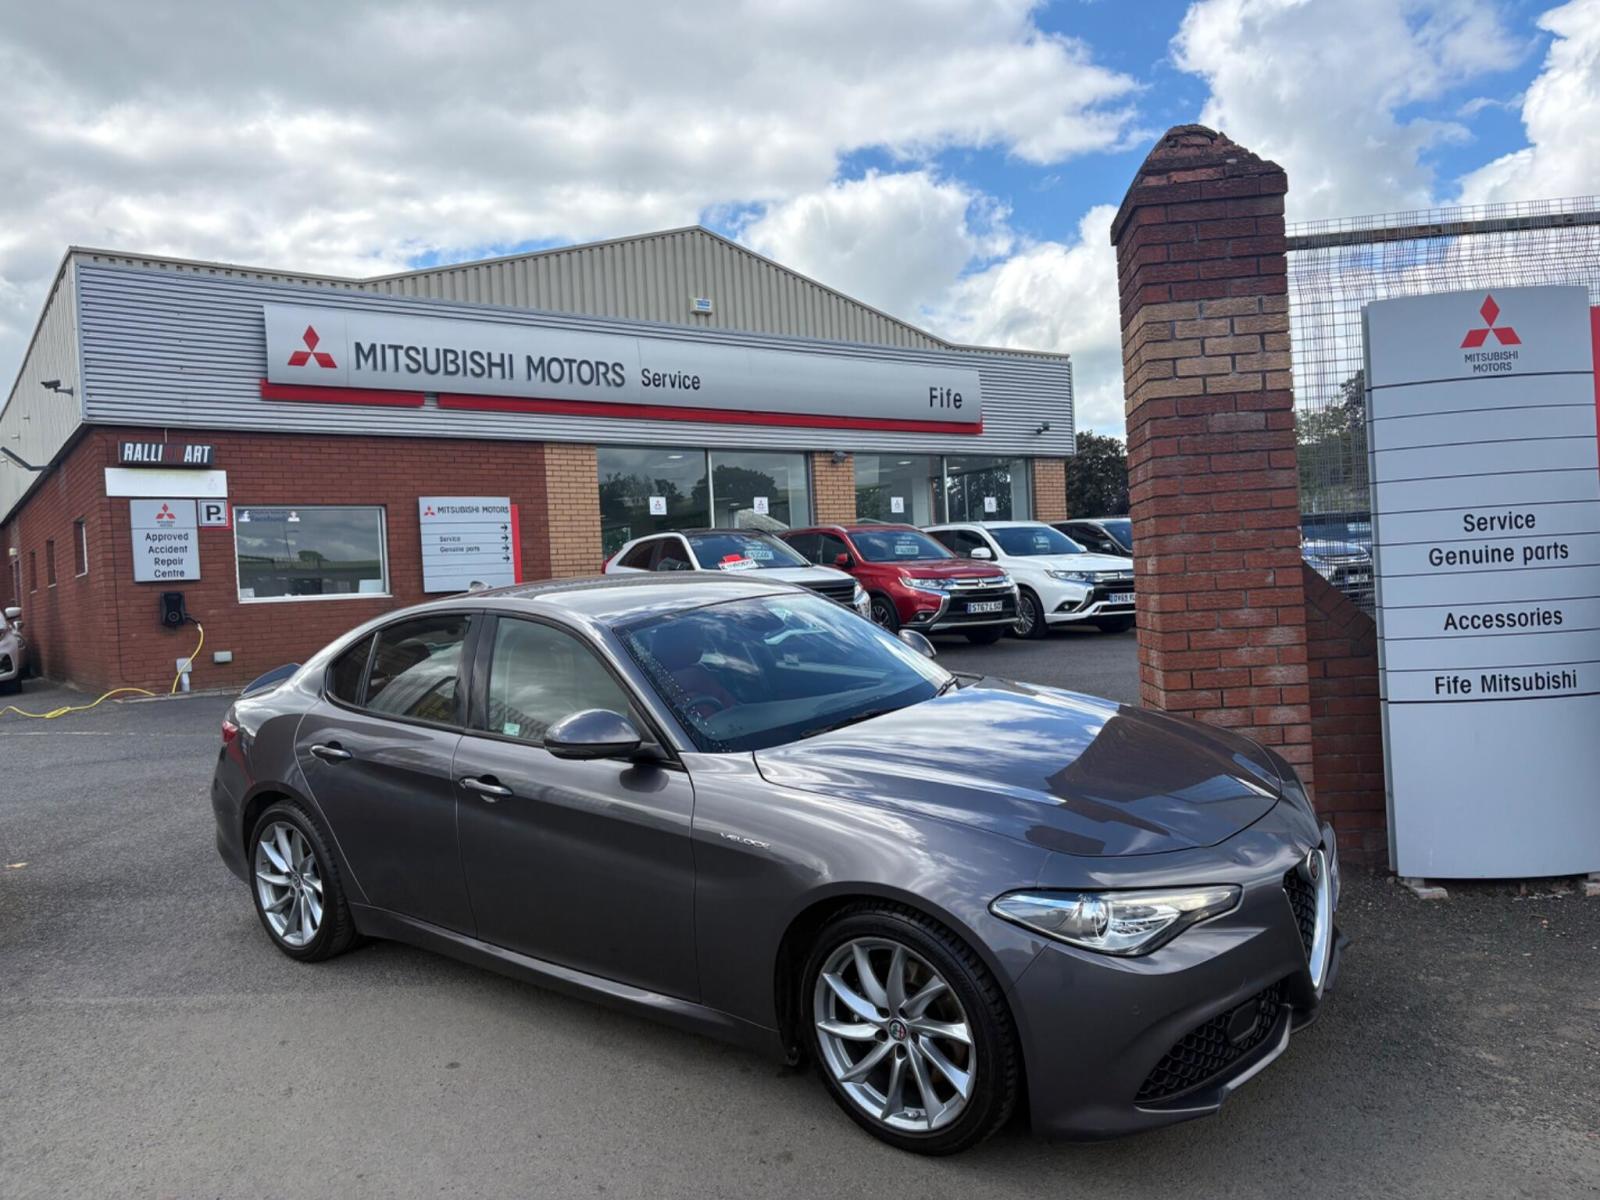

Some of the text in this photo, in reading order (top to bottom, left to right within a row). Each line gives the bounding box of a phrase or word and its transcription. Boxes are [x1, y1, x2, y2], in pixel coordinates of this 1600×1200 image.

[1464, 350, 1519, 363] MITSUBISHI
[354, 341, 701, 391] MITSUBISHI MOTORS Service
[1473, 361, 1512, 373] MOTORS
[929, 386, 963, 410] Fife
[205, 504, 221, 521] P
[437, 505, 509, 514] MITSUBISHI MOTORS
[1463, 511, 1536, 532] Service
[145, 532, 189, 543] Approved
[148, 545, 188, 554] Accident
[1429, 541, 1569, 567] Genuine parts
[154, 557, 184, 566] Repair
[154, 569, 185, 578] Centre
[1443, 607, 1563, 631] Accessories
[1434, 669, 1577, 695] Fife Mitsubishi
